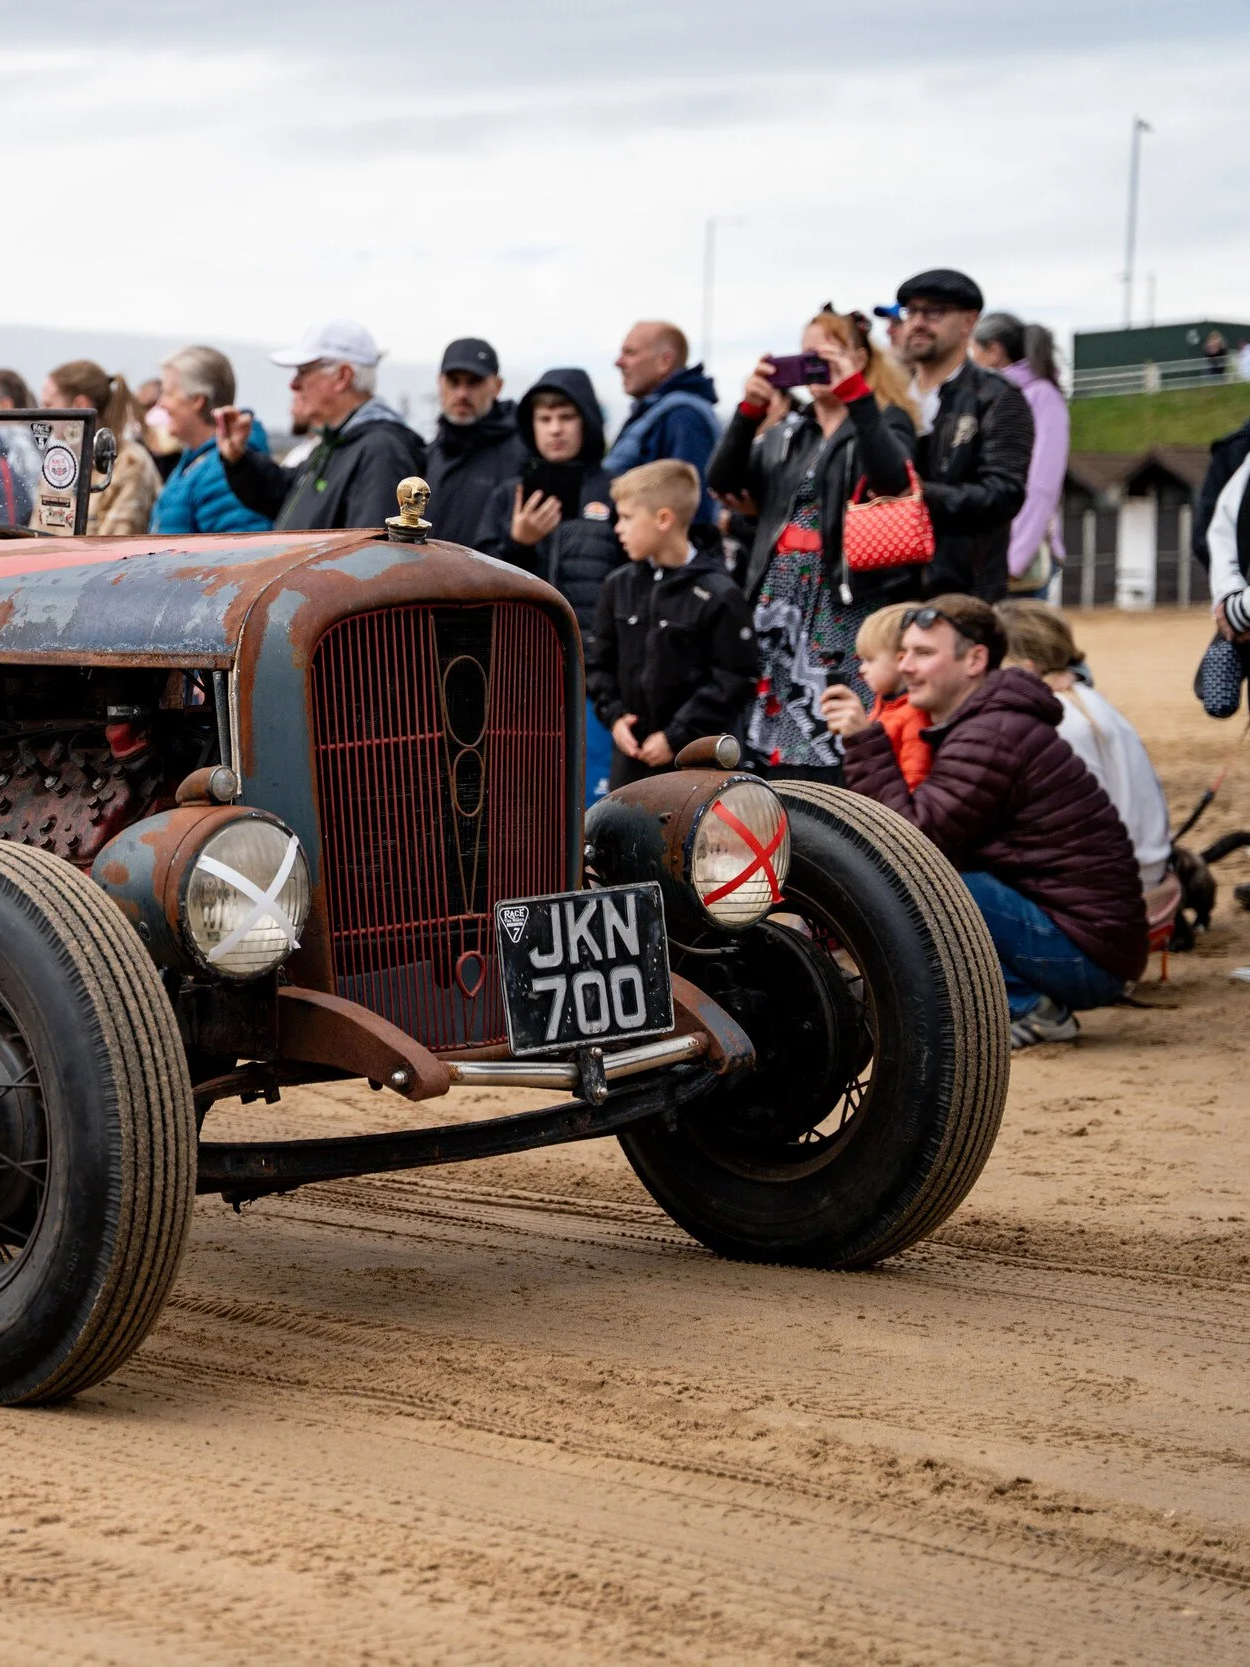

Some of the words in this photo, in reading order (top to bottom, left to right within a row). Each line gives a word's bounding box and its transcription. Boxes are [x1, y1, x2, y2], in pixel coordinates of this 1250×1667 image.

[504, 908, 525, 919] RACE
[513, 927, 520, 941] 7
[529, 893, 640, 969] JKN
[531, 964, 647, 1041] 700
